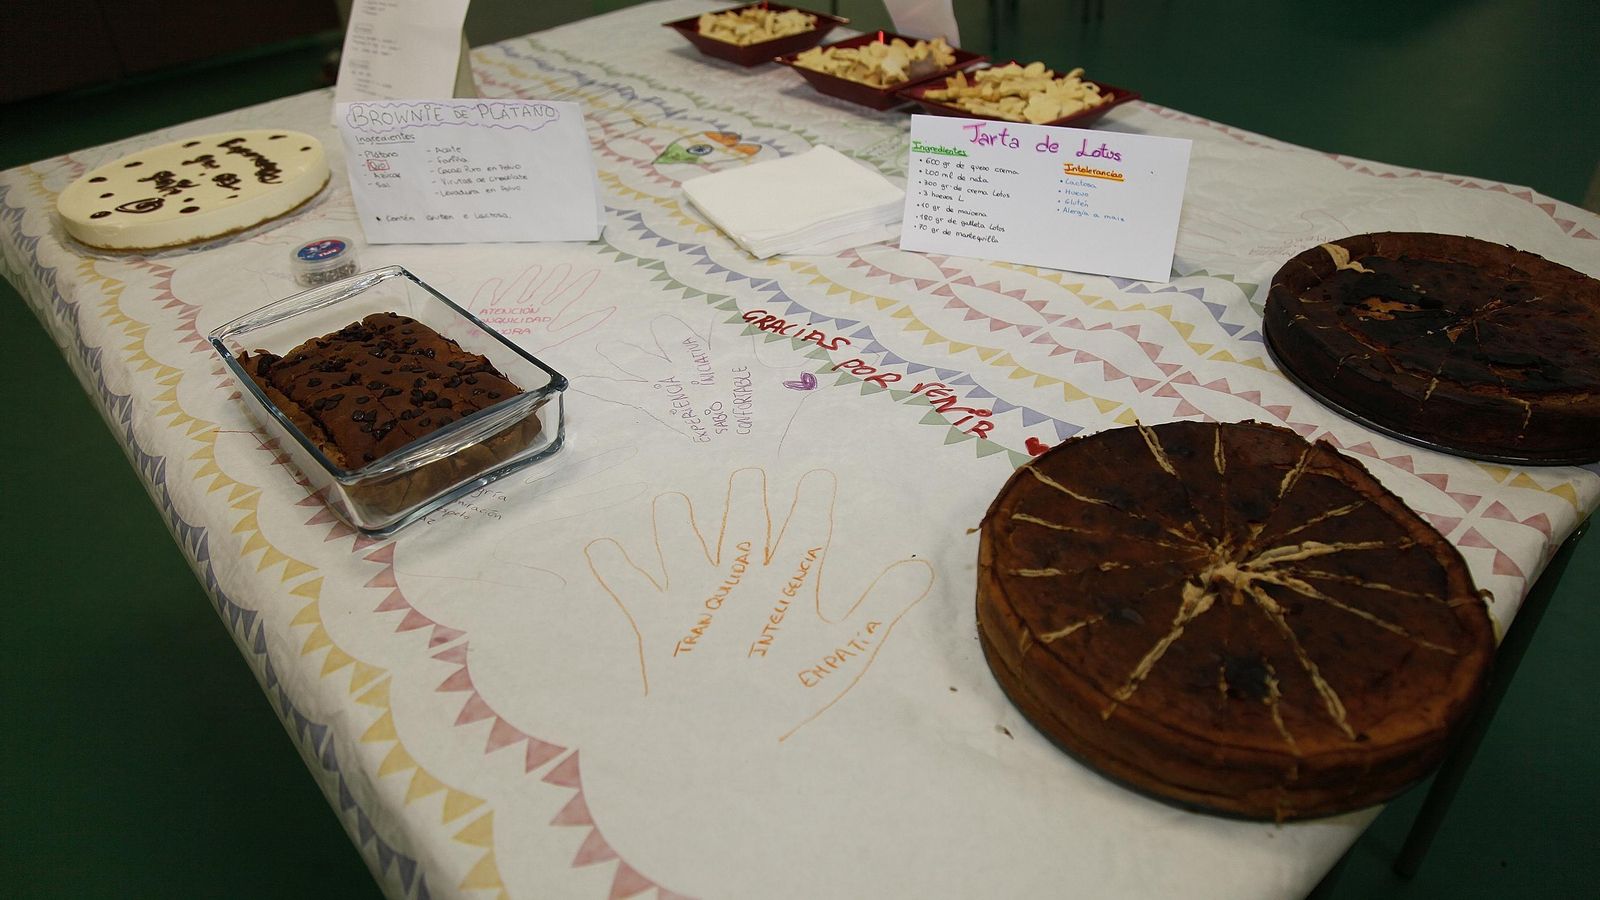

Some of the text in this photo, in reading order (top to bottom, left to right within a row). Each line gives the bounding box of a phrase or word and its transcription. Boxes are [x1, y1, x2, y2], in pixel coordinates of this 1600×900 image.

[352, 104, 444, 127] BROWNIE
[453, 110, 469, 119] DE
[355, 132, 416, 145] Ingredientes
[963, 121, 1123, 162] Tarta de Lotus
[912, 140, 968, 157] Ingredientes
[925, 157, 940, 166] 600
[956, 161, 965, 169] de
[994, 167, 1020, 175] crema
[941, 171, 953, 179] ml
[957, 173, 966, 181] de
[969, 175, 989, 183] nata
[924, 179, 937, 187] 300
[953, 183, 962, 191] de
[966, 188, 988, 196] crema
[958, 194, 964, 202] L
[946, 205, 954, 213] de
[958, 208, 987, 217] maicena
[947, 217, 957, 225] de
[960, 220, 985, 229] galleta
[919, 223, 928, 231] 70
[942, 228, 951, 236] de
[955, 231, 999, 243] mantequilla
[831, 358, 902, 389] POR
[656, 375, 711, 443] EXPERIENCIA
[732, 366, 753, 435] CONFORTABLE
[704, 401, 728, 435] SABIO
[748, 546, 823, 658] INTELIGENCIA
